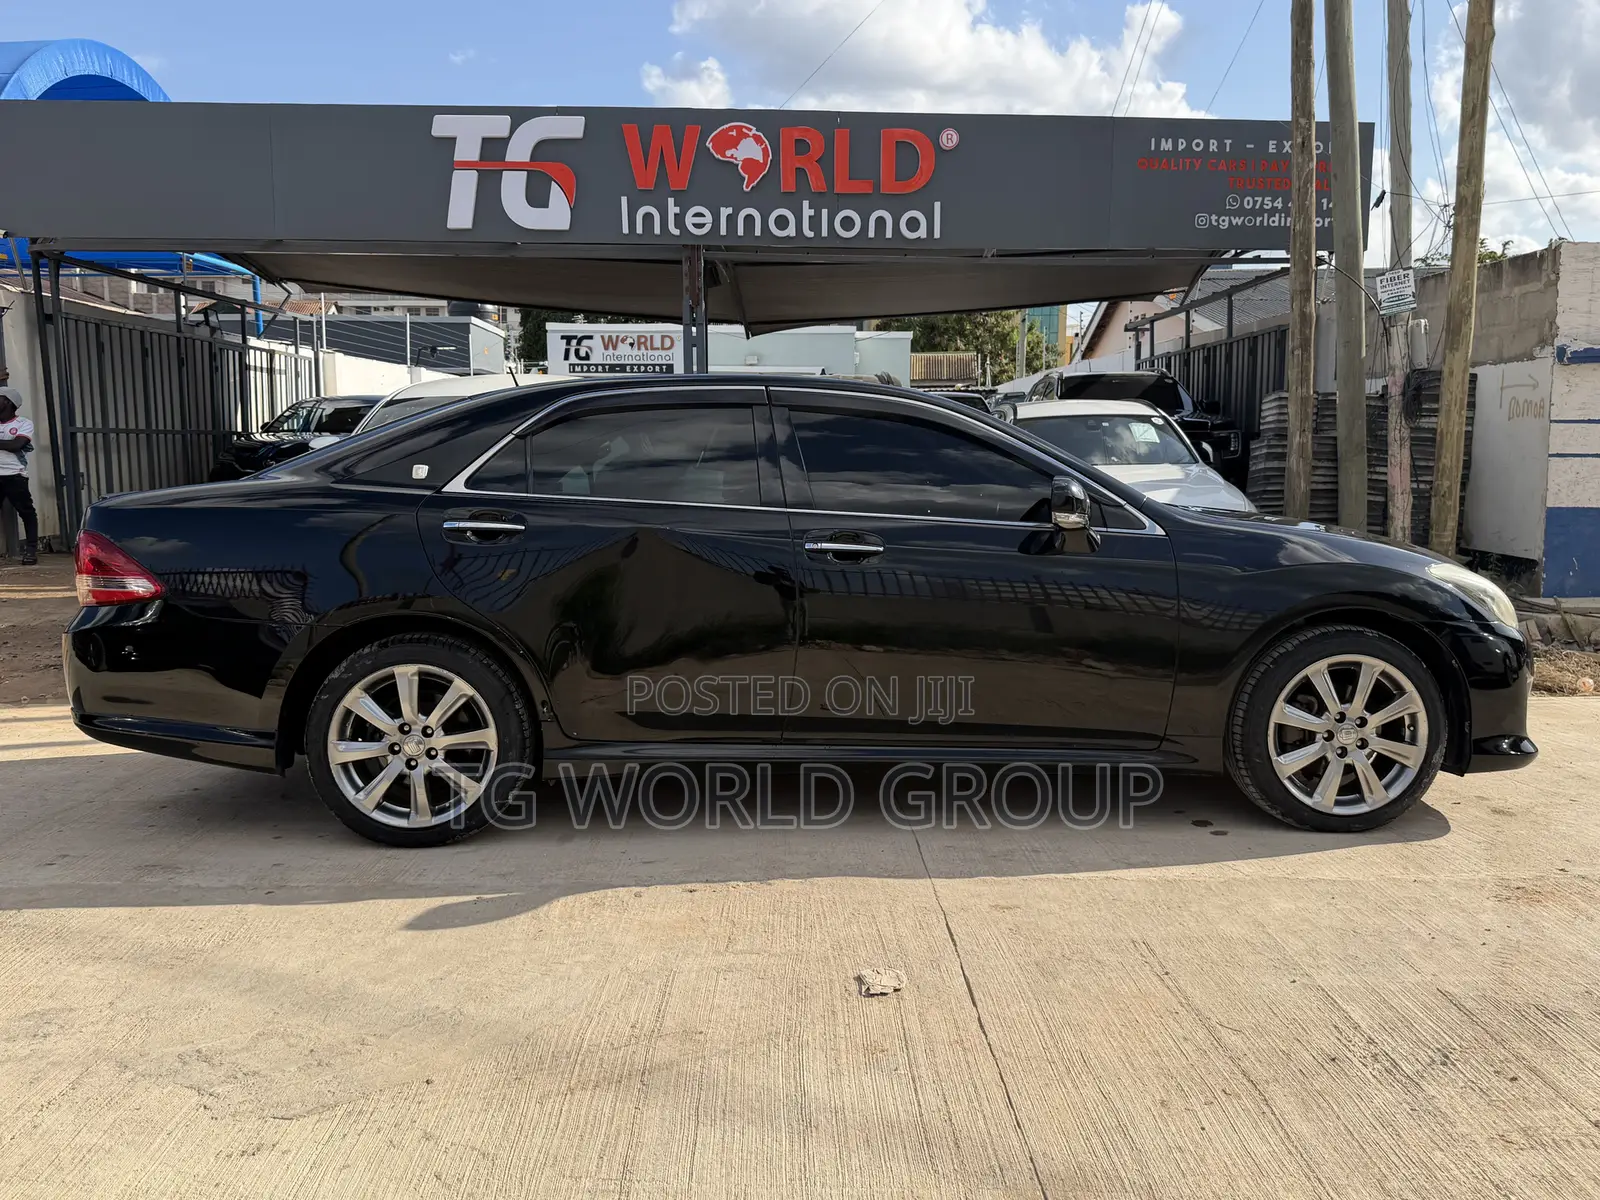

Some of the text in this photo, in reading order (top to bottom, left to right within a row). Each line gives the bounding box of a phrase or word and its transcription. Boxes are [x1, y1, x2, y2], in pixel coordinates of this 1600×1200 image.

[1150, 137, 1232, 152] IMPORT
[1268, 140, 1332, 154] EXO
[431, 114, 585, 230] TG
[1137, 157, 1202, 171] QUALITY
[1207, 158, 1247, 172] CARS
[1228, 176, 1292, 191] TRUSTED
[1243, 195, 1283, 210] 0754
[621, 196, 942, 239] International
[1380, 272, 1410, 285] FIBER
[1380, 279, 1411, 290] INTERNET
[560, 334, 594, 361] TG
[602, 352, 674, 362] International
[626, 365, 667, 373] EXPORT
